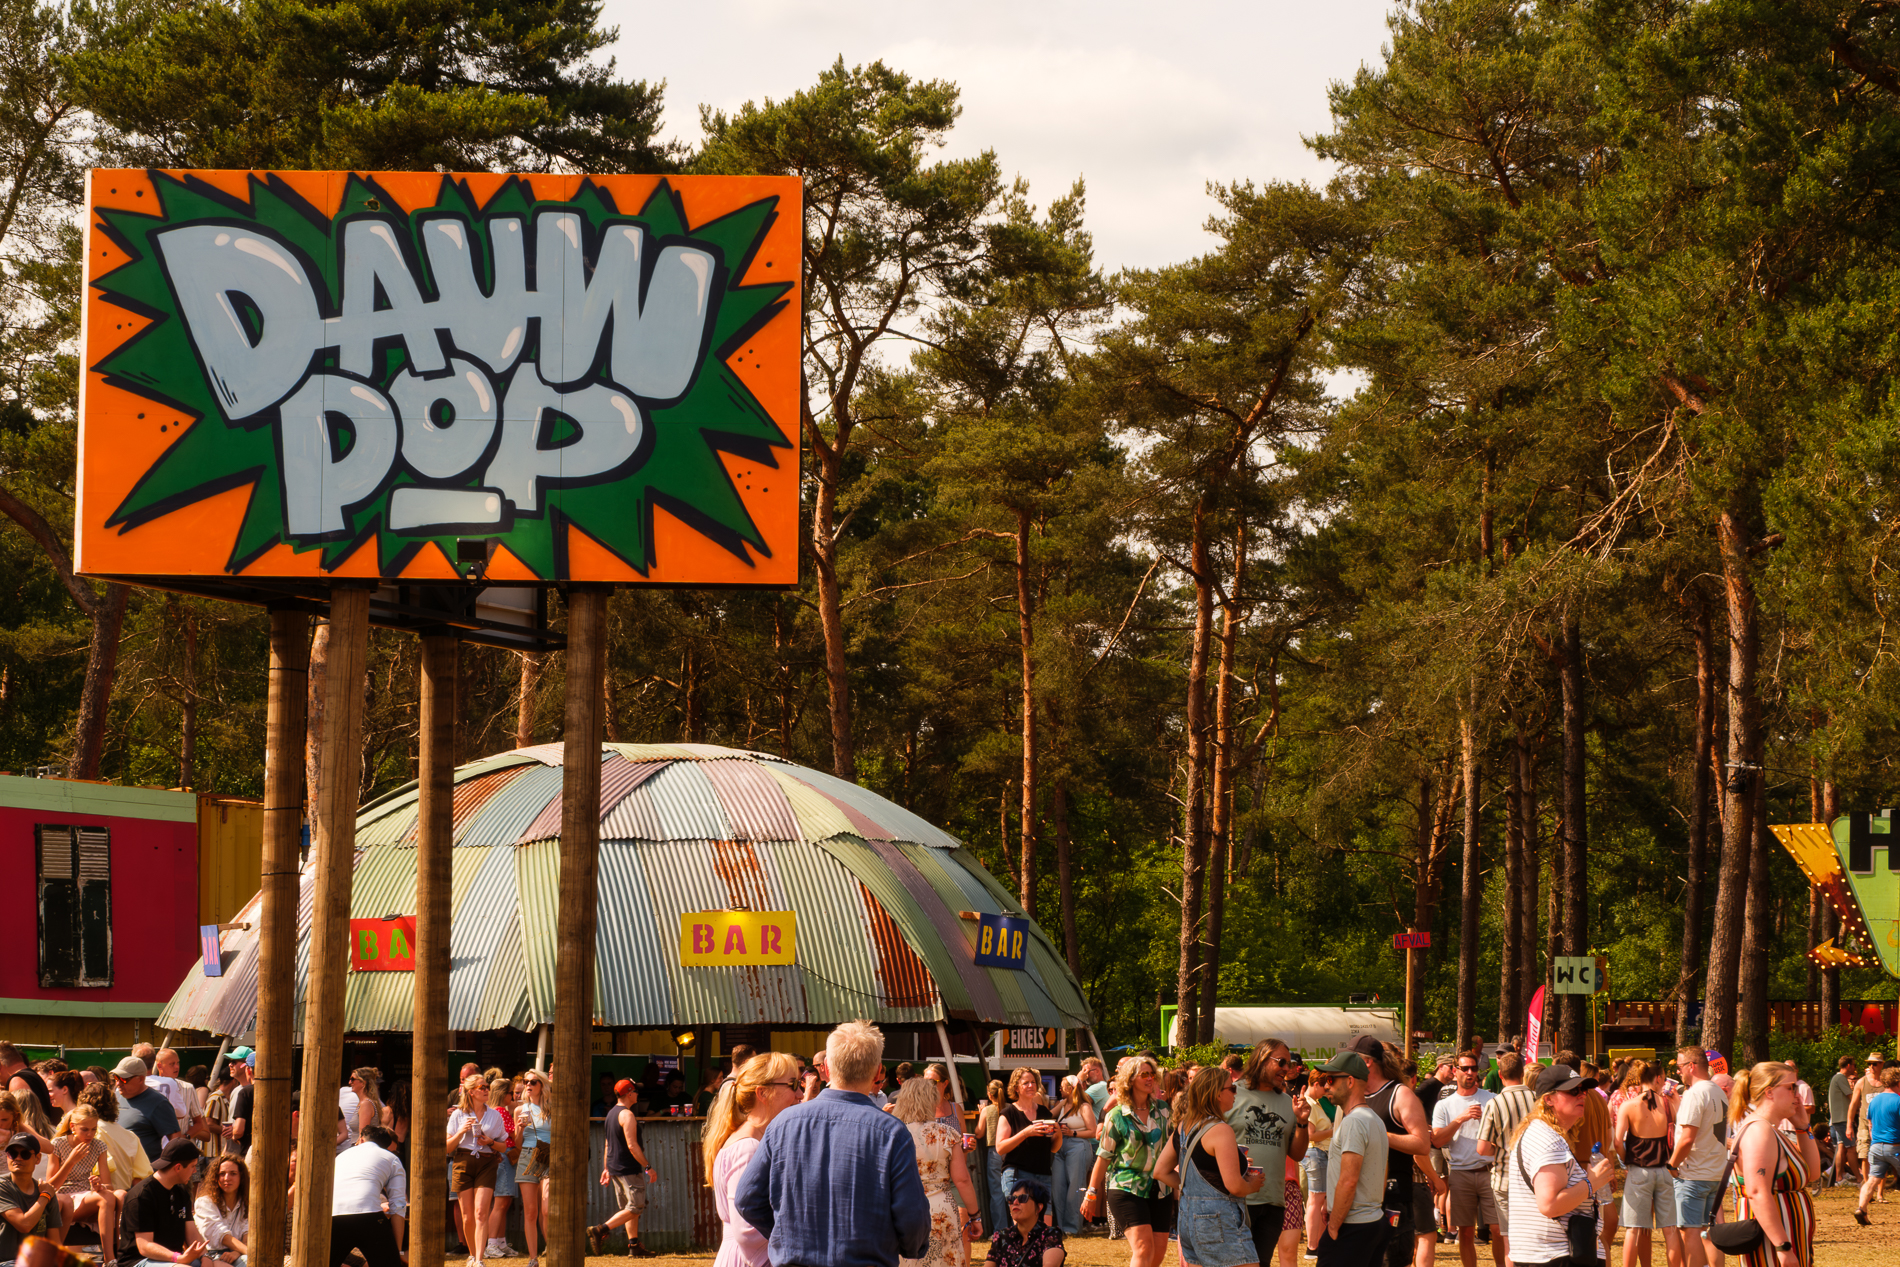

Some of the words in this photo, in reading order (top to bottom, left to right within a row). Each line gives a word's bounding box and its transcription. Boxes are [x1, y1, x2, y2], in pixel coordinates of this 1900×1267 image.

[277, 357, 646, 536] POP
[202, 936, 219, 966] BAR
[359, 928, 410, 960] BA
[692, 923, 782, 955] BAR
[981, 925, 1023, 960] BAR
[1395, 933, 1430, 947] AFVAL
[1557, 966, 1589, 984] WC
[1010, 1027, 1045, 1050] EIKELS
